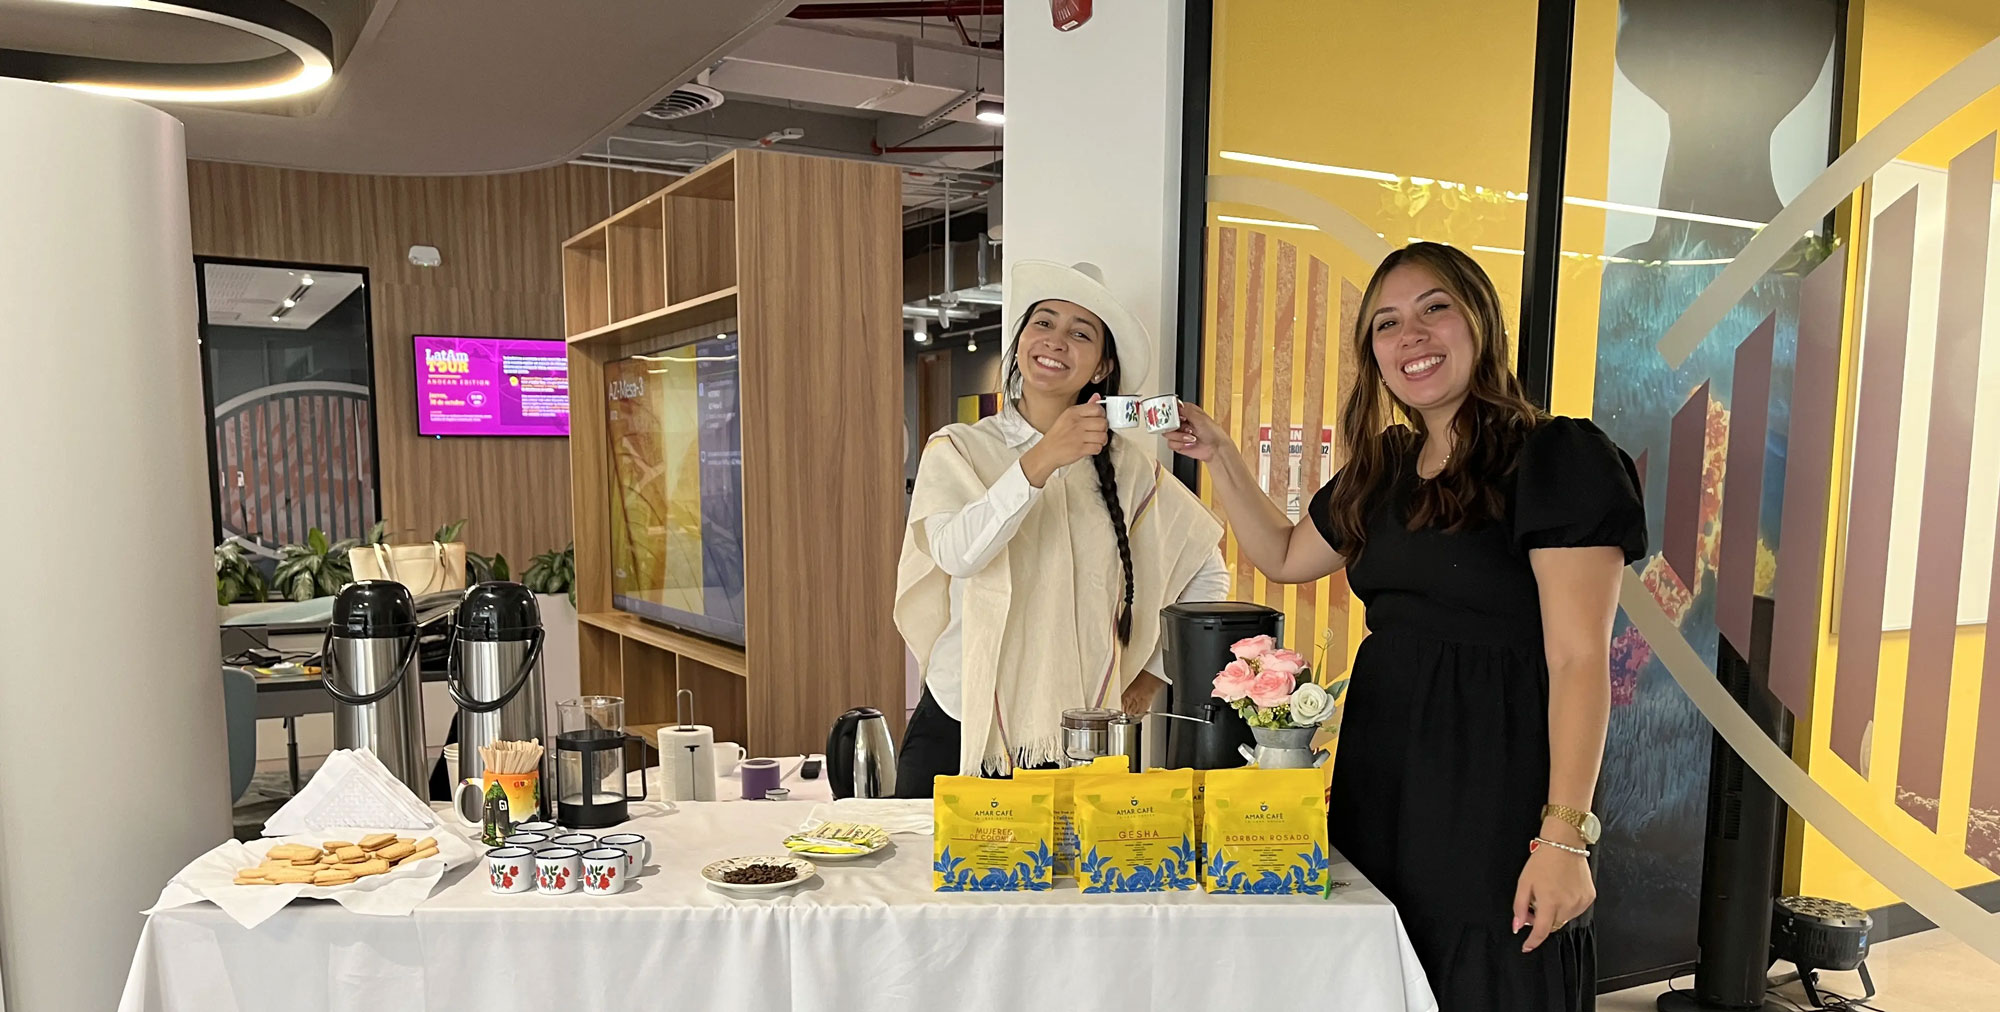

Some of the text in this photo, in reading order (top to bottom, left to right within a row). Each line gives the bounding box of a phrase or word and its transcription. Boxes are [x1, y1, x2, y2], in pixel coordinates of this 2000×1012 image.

[425, 348, 469, 362] LatAm
[427, 361, 469, 373] TOUR
[976, 827, 1013, 835] MUJERES
[1118, 830, 1160, 839] GESHA
